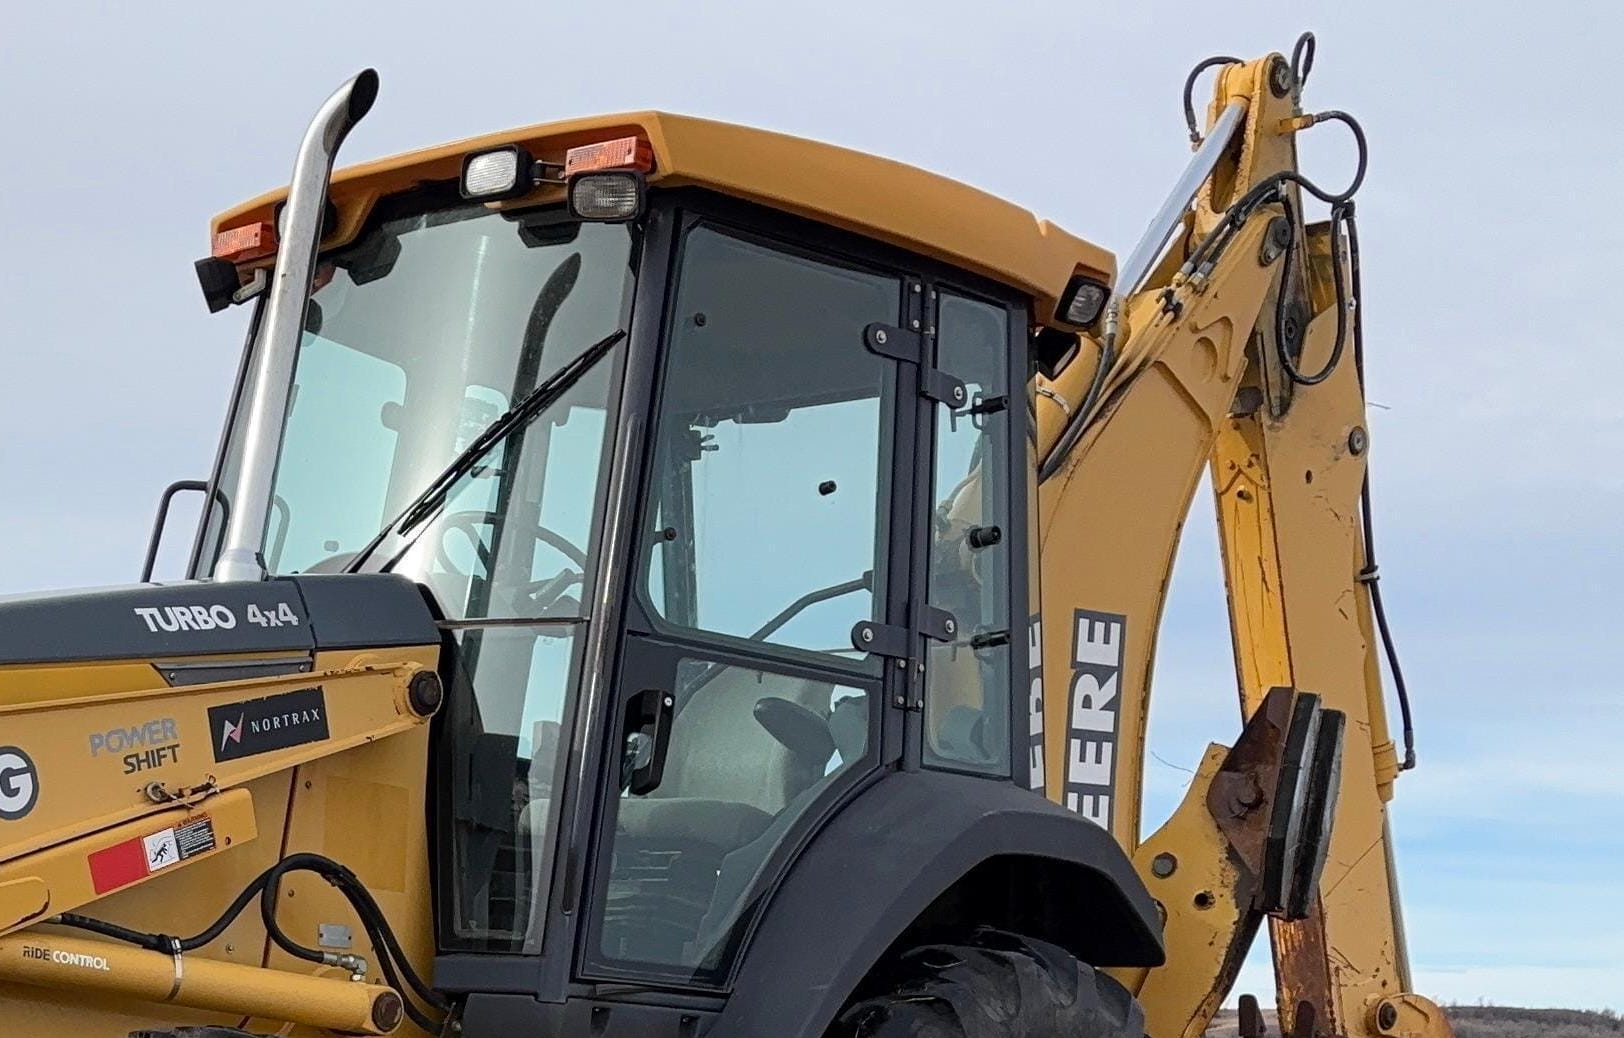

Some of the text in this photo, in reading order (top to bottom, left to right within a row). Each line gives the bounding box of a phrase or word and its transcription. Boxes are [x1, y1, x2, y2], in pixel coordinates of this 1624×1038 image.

[134, 603, 299, 632] TURBO 4x4
[251, 708, 321, 734] NORTRAX
[89, 718, 179, 757] POWER
[123, 743, 180, 775] SHIFT
[22, 945, 111, 971] RIDE CONTROL
